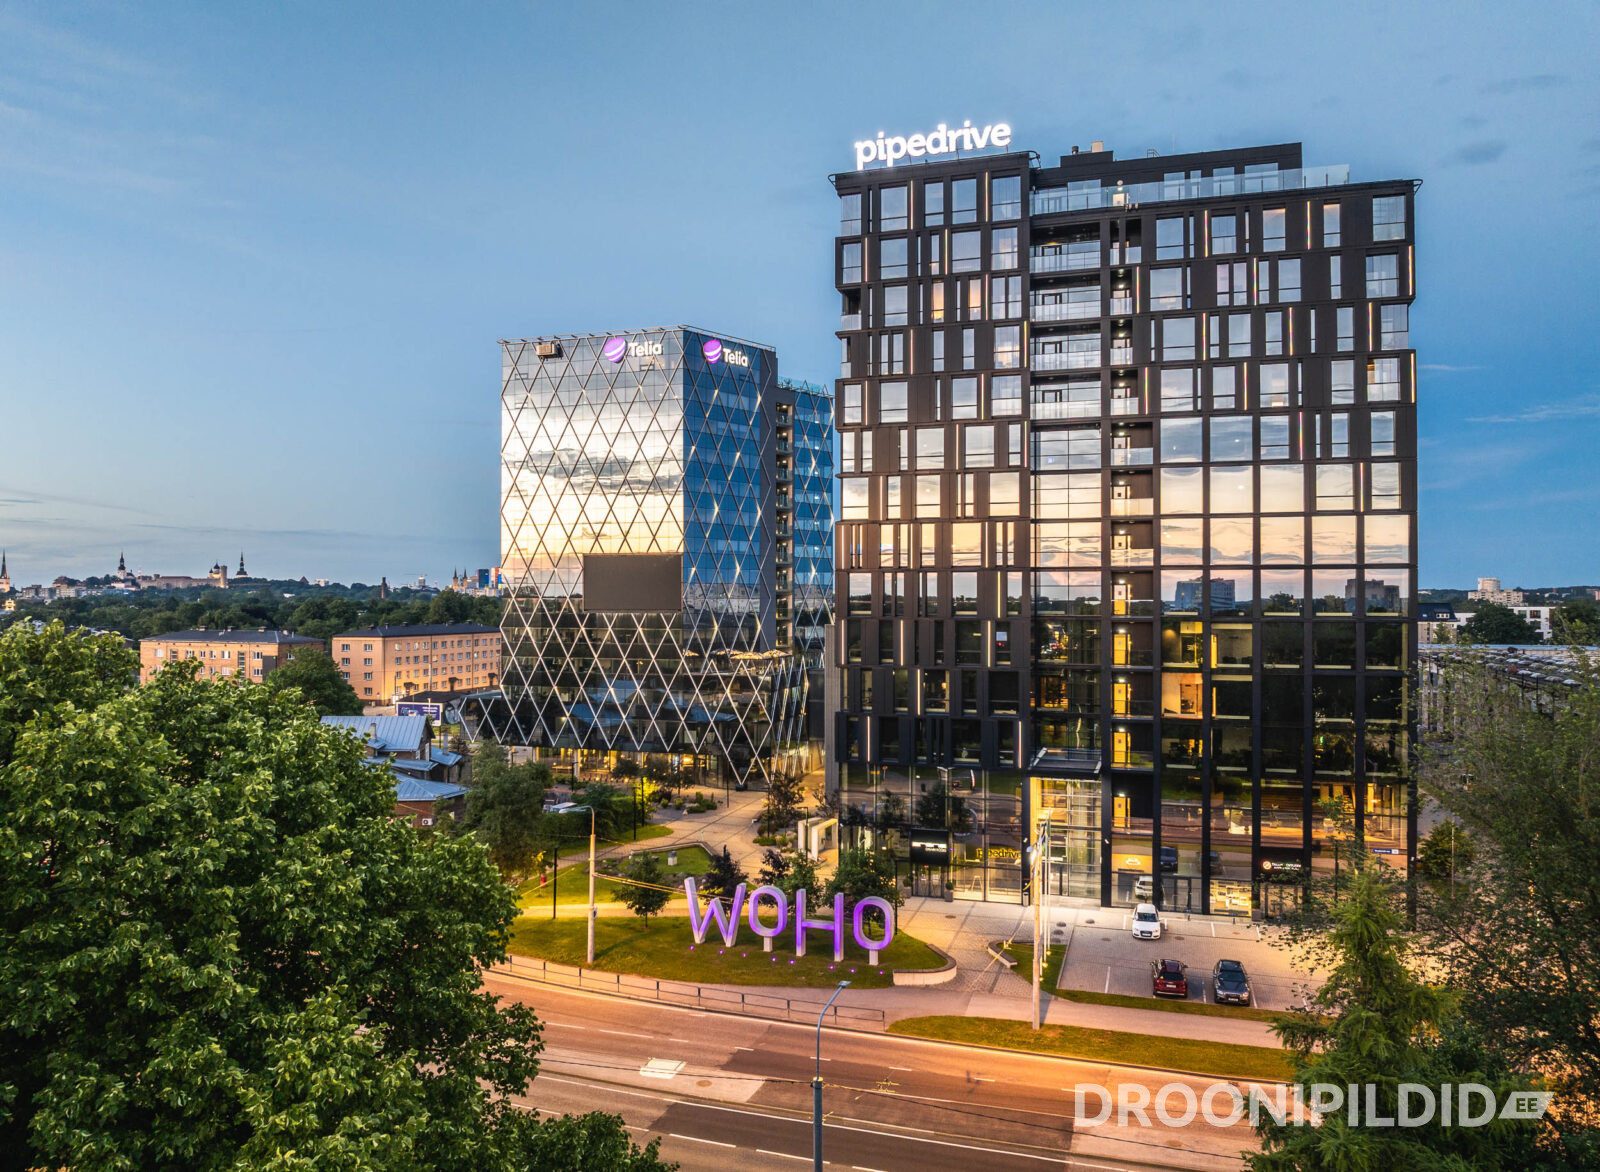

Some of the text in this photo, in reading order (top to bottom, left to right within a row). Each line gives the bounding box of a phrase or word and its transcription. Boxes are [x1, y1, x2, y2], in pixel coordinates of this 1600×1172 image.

[854, 120, 1011, 170] pipedrive
[627, 341, 663, 357] Telia
[723, 348, 748, 367] Telia
[684, 876, 895, 965] WOHO
